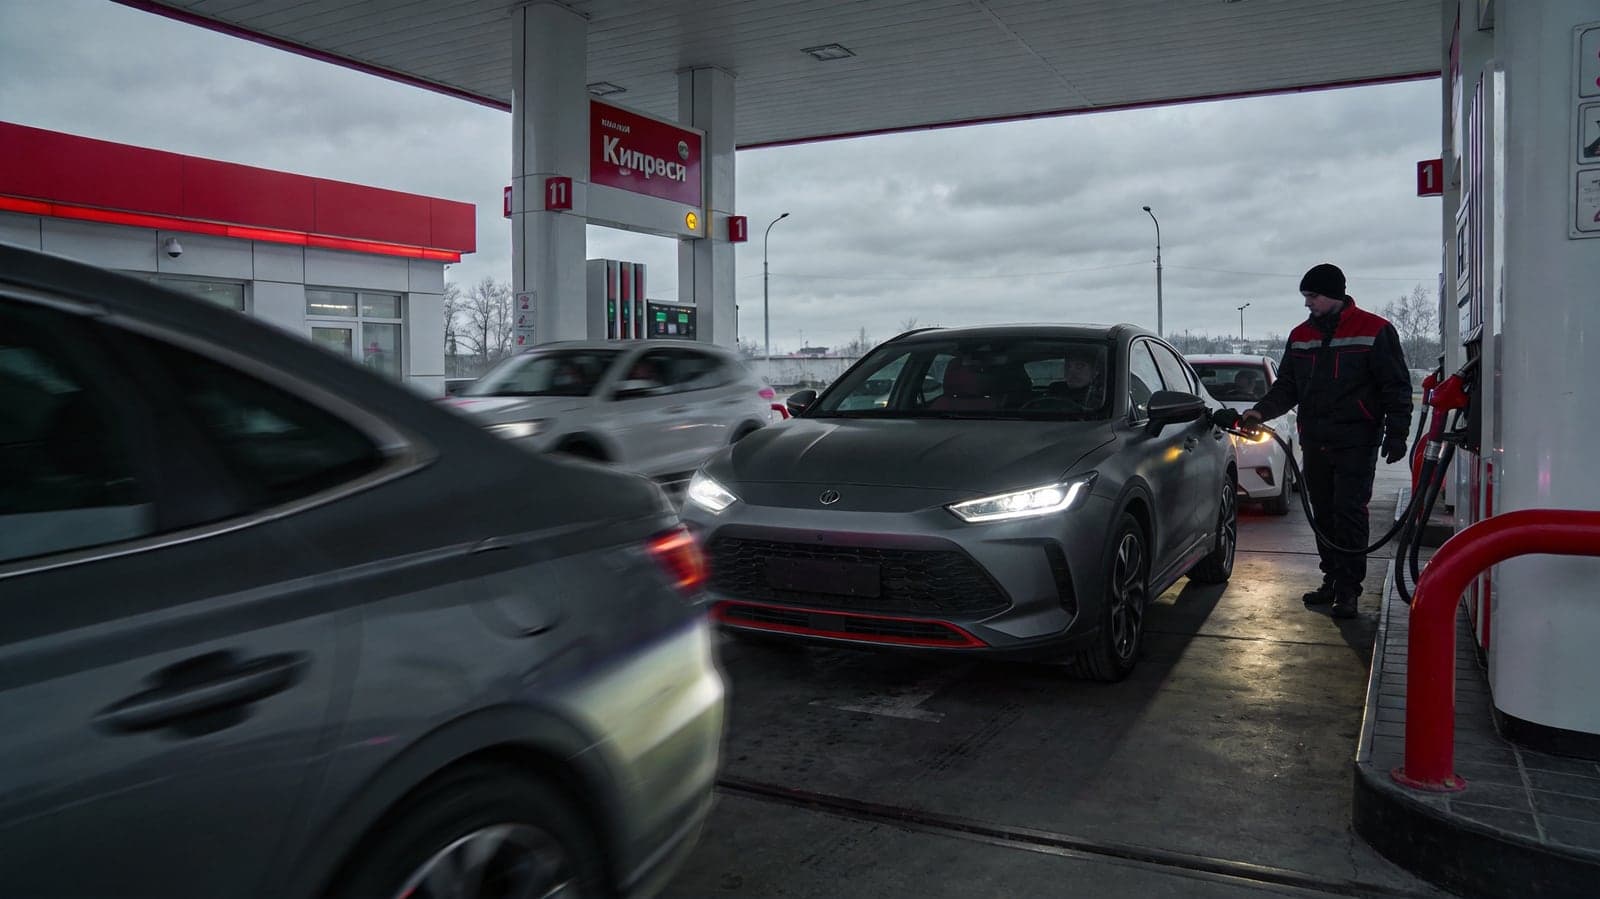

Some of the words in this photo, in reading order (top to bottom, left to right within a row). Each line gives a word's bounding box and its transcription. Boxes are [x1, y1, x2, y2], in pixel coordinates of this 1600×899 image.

[1423, 164, 1433, 189] 1
[550, 182, 566, 205] 11
[735, 218, 743, 238] 1
